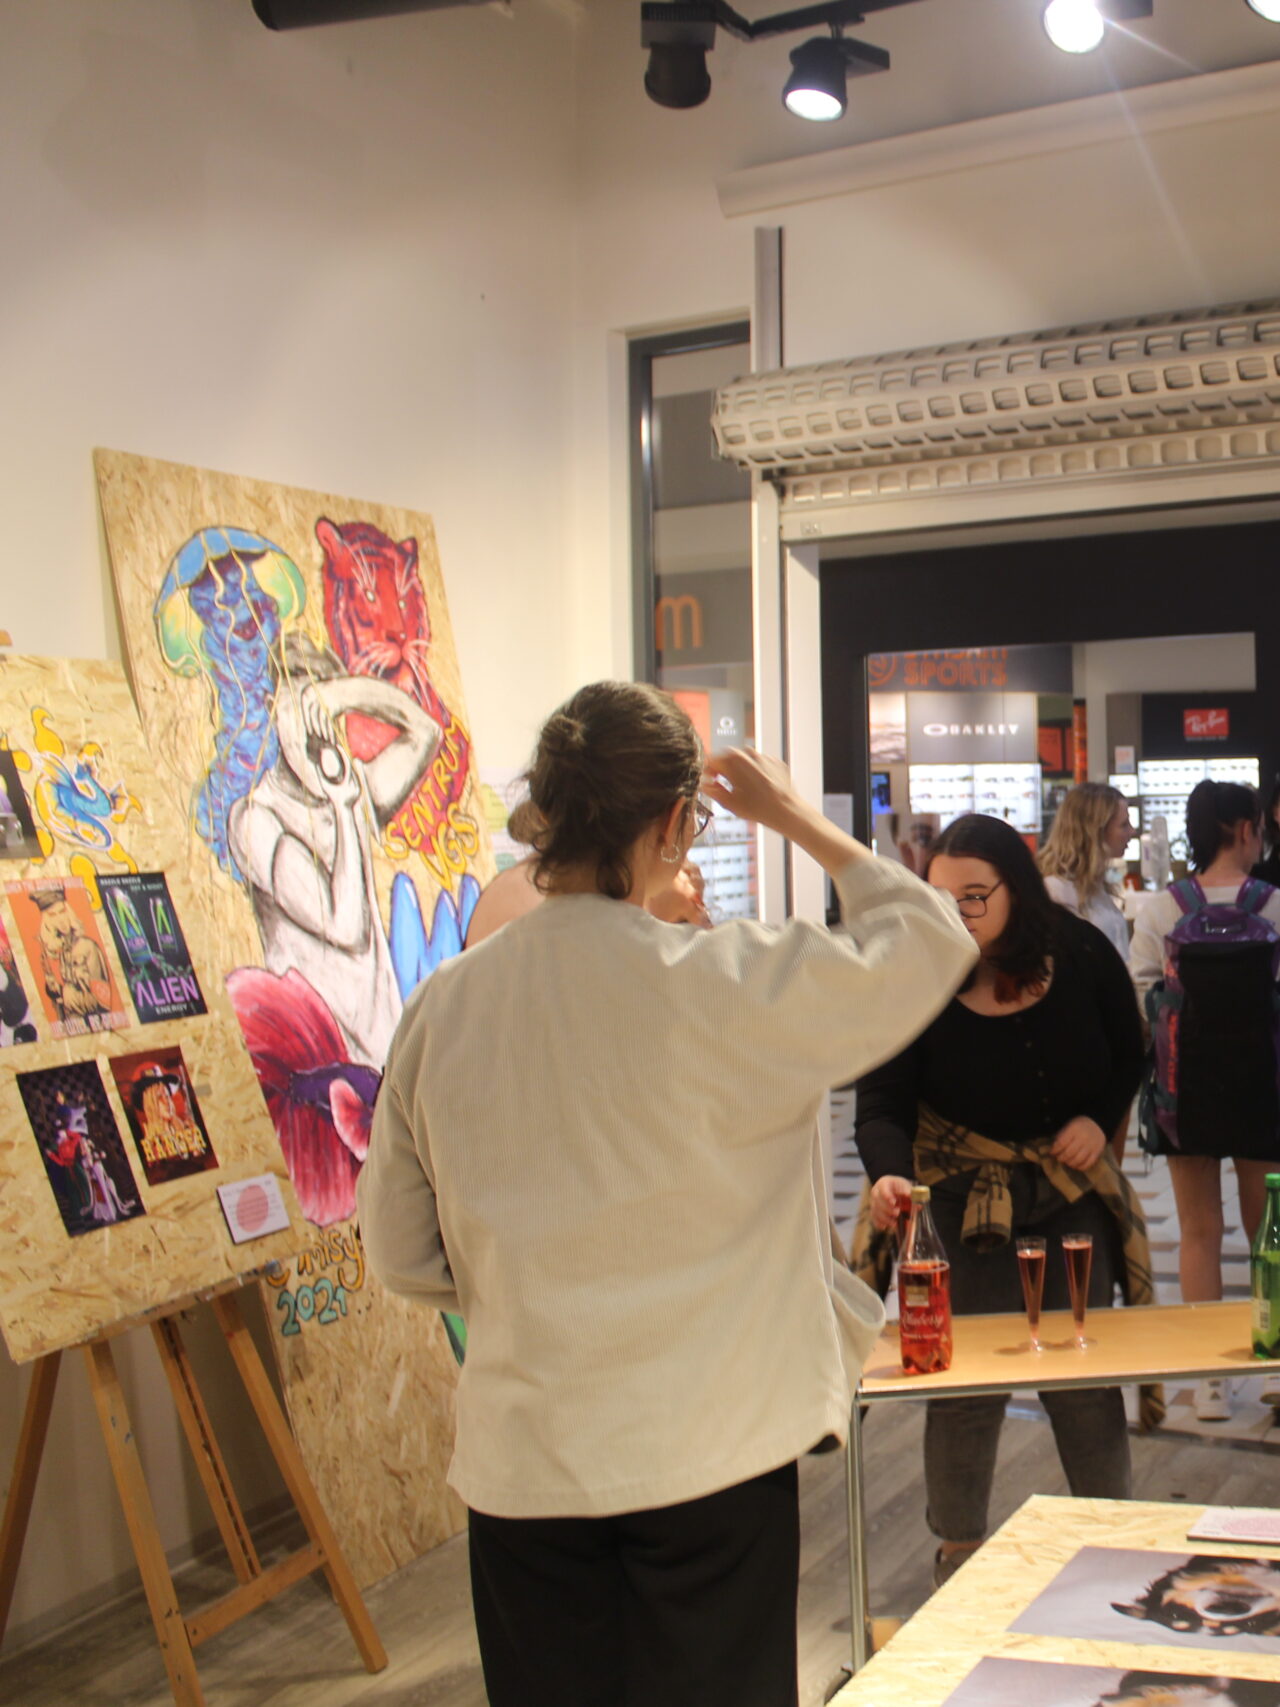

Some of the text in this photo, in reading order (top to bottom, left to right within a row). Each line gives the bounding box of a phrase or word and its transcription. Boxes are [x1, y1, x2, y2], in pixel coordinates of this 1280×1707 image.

[904, 660, 1008, 687] SPORTS
[923, 723, 1019, 737] OAKLEY
[384, 715, 470, 860] SENTRUM
[420, 803, 480, 892] VGS
[136, 975, 201, 1009] ALIEN
[155, 1003, 188, 1015] ENERGY
[276, 1277, 348, 1336] 2021
